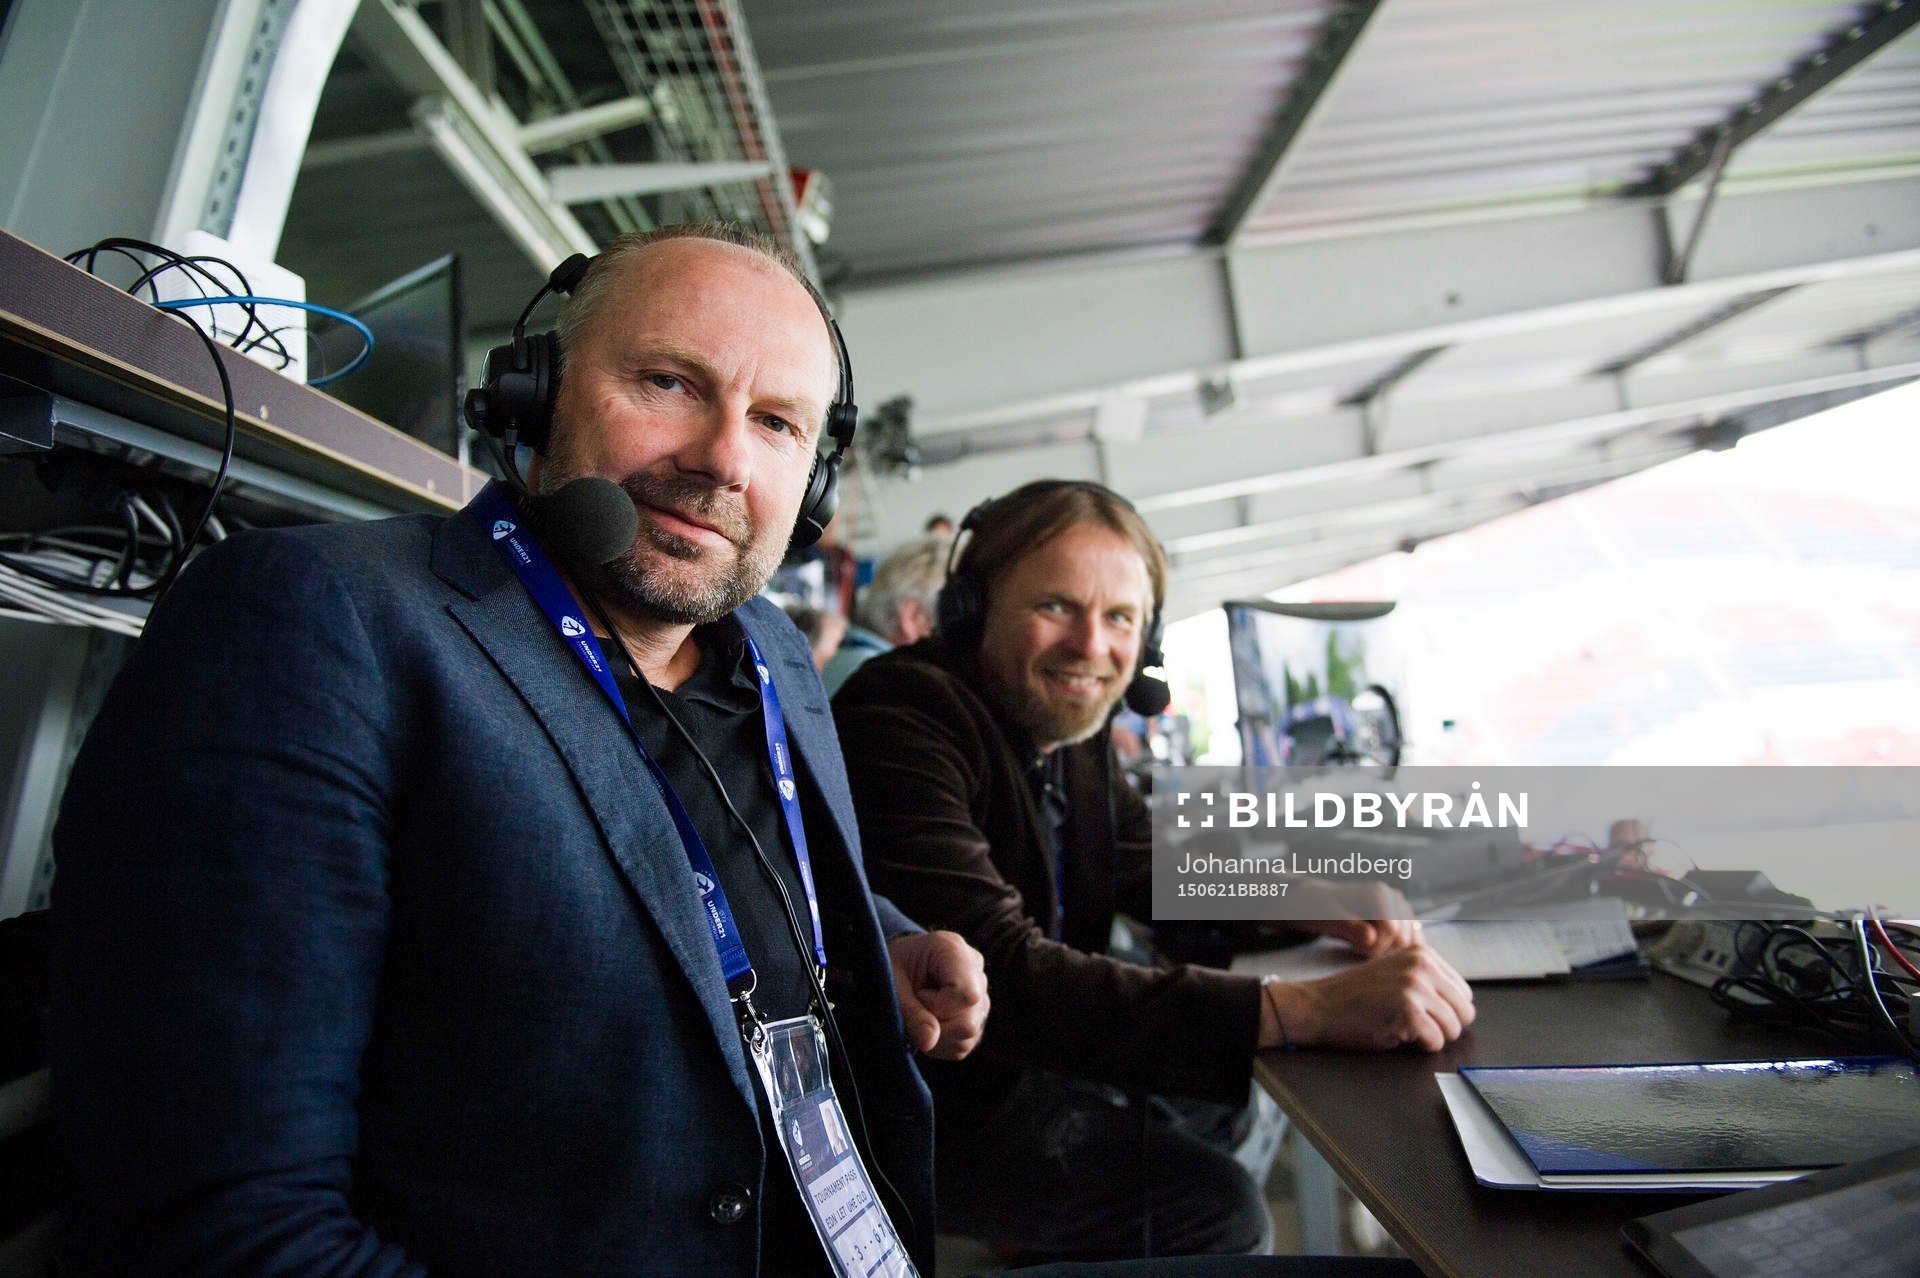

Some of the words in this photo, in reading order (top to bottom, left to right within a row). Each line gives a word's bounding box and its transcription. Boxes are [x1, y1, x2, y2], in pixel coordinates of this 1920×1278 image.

[509, 537, 532, 564] UNDER21
[581, 640, 603, 673] UNDER21
[707, 900, 727, 939] UNDER21
[814, 1176, 847, 1205] TOURNAMENT
[844, 1169, 858, 1186] PASS
[836, 1205, 847, 1220] LET
